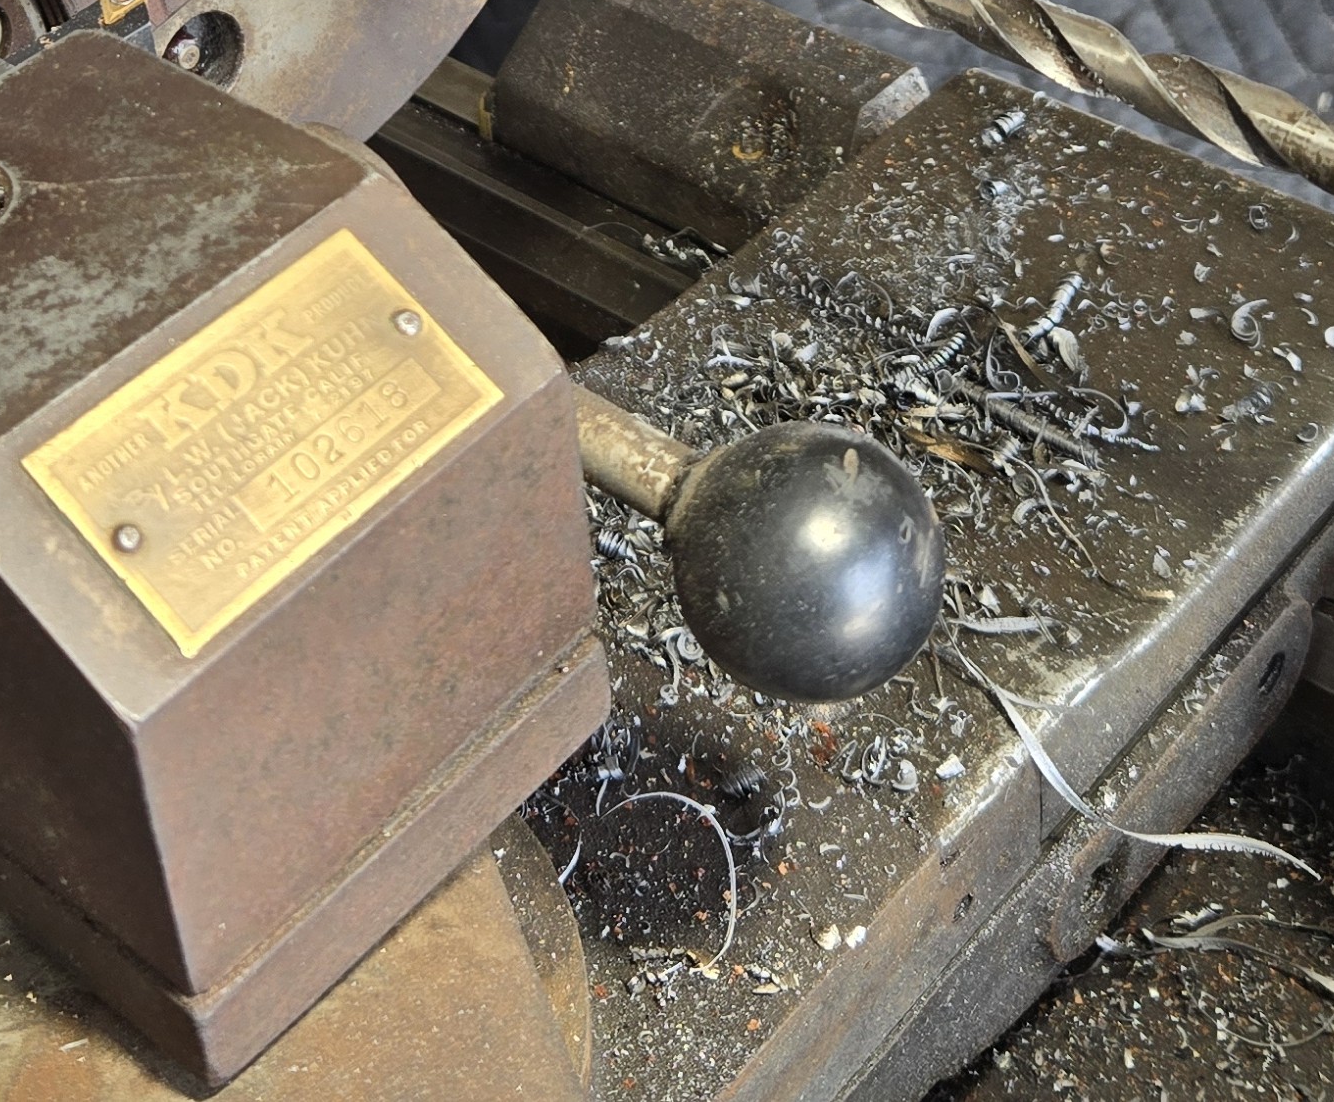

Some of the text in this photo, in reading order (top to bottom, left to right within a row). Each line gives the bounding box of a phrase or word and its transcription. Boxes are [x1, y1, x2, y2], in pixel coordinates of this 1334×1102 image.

[77, 272, 368, 492] ANOTHER KDK PRODUCT
[215, 367, 310, 442] (JACK)
[264, 382, 411, 498] 102618
[168, 504, 240, 565] SERIAL
[235, 419, 430, 578] PATENT APPLIED FOR
[200, 537, 245, 570] NO.
